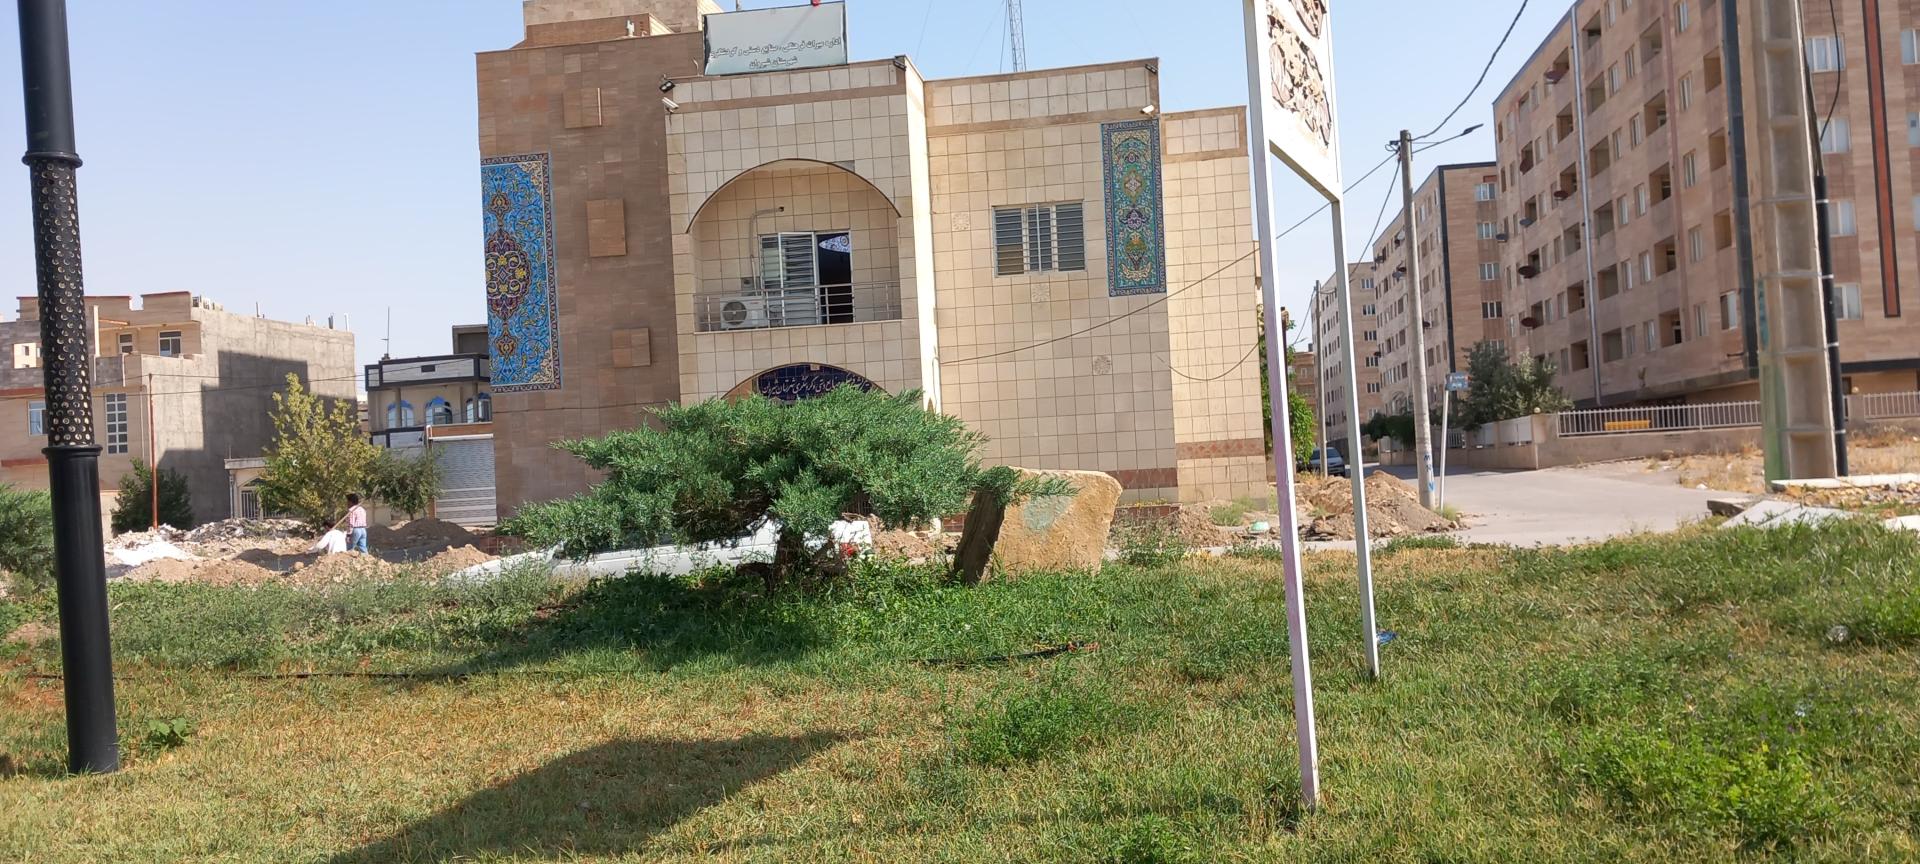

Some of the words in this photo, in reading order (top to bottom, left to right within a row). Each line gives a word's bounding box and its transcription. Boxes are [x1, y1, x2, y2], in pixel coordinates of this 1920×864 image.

[807, 39, 824, 50] میراث
[825, 36, 841, 48] اداره
[772, 56, 798, 66] شهرستان
